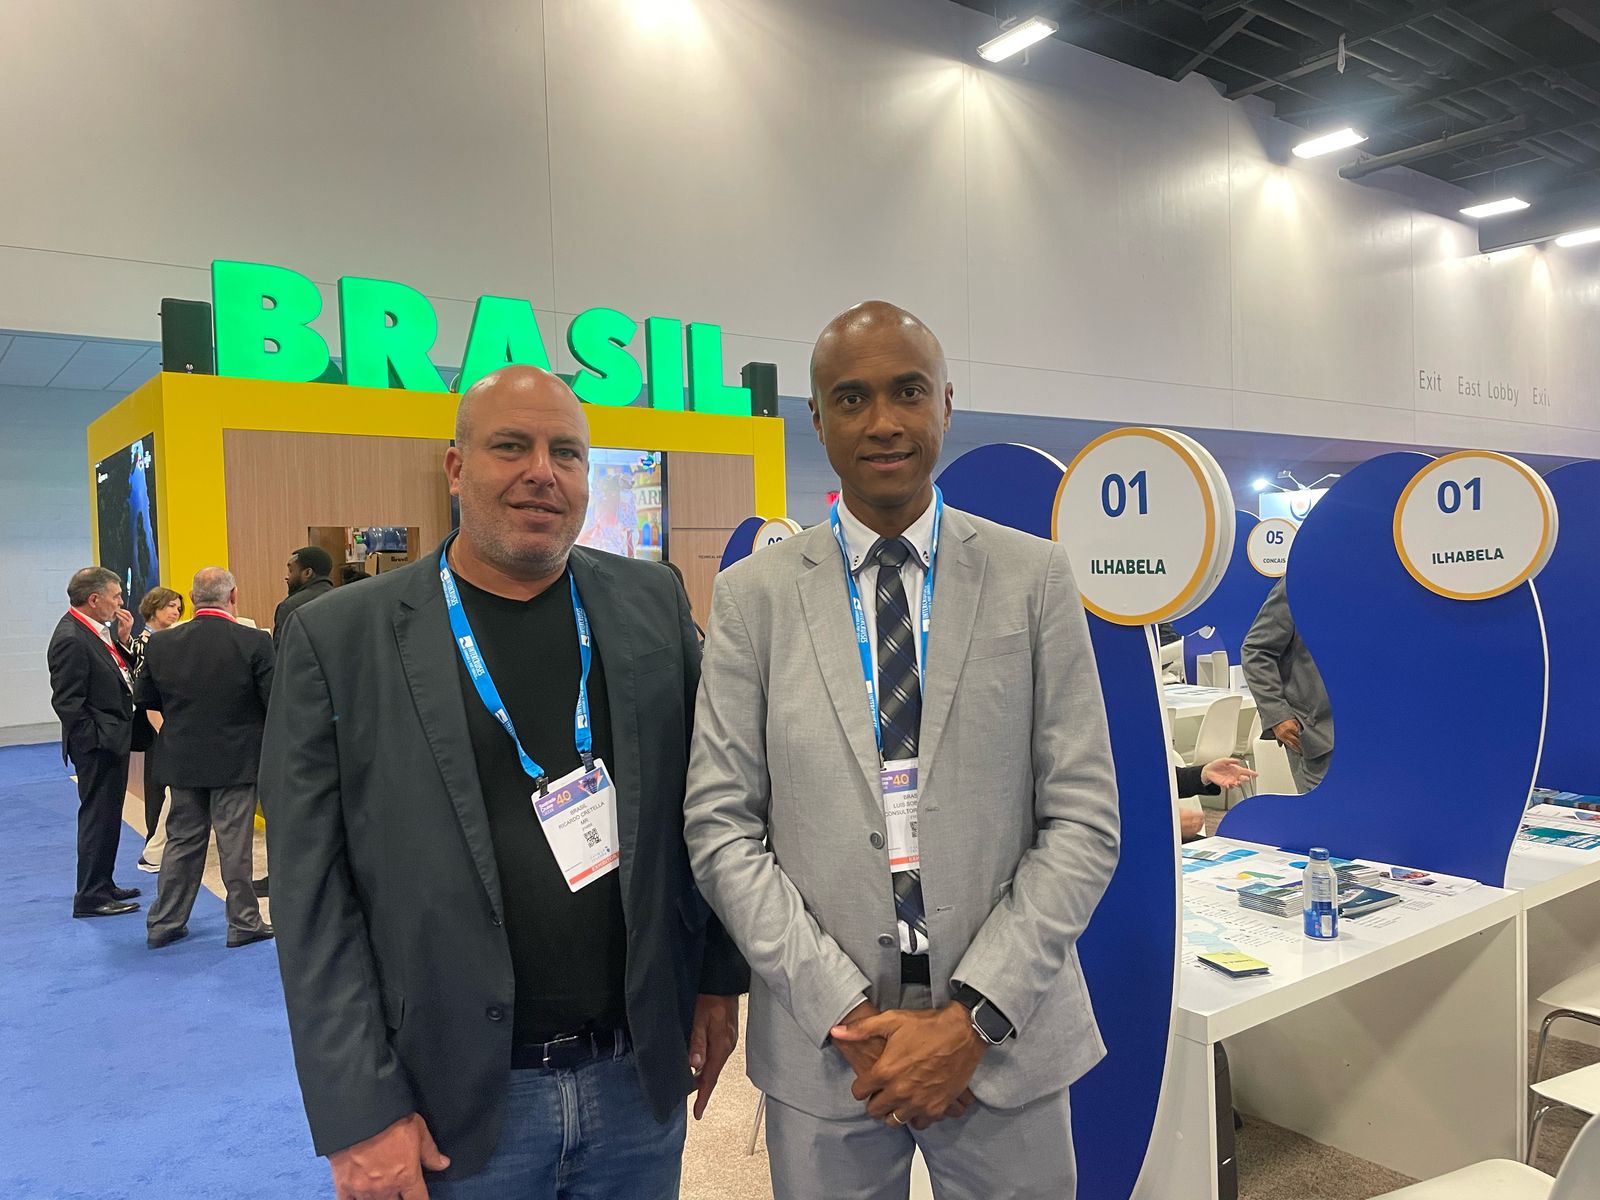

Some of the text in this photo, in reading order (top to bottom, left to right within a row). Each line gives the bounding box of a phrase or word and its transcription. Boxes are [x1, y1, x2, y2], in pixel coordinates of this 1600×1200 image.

[211, 259, 753, 417] BRASIL
[1419, 370, 1442, 392] Exit
[1458, 376, 1481, 398] East
[1487, 380, 1519, 407] Lobby
[1101, 470, 1148, 518] 01
[1437, 477, 1481, 514] 01
[1266, 530, 1284, 544] 05
[1091, 559, 1167, 575] ILHABELA
[1432, 547, 1505, 565] ILHABELA
[468, 646, 485, 677] INTERCRUISES
[892, 773, 910, 786] 40
[556, 790, 572, 806] 40
